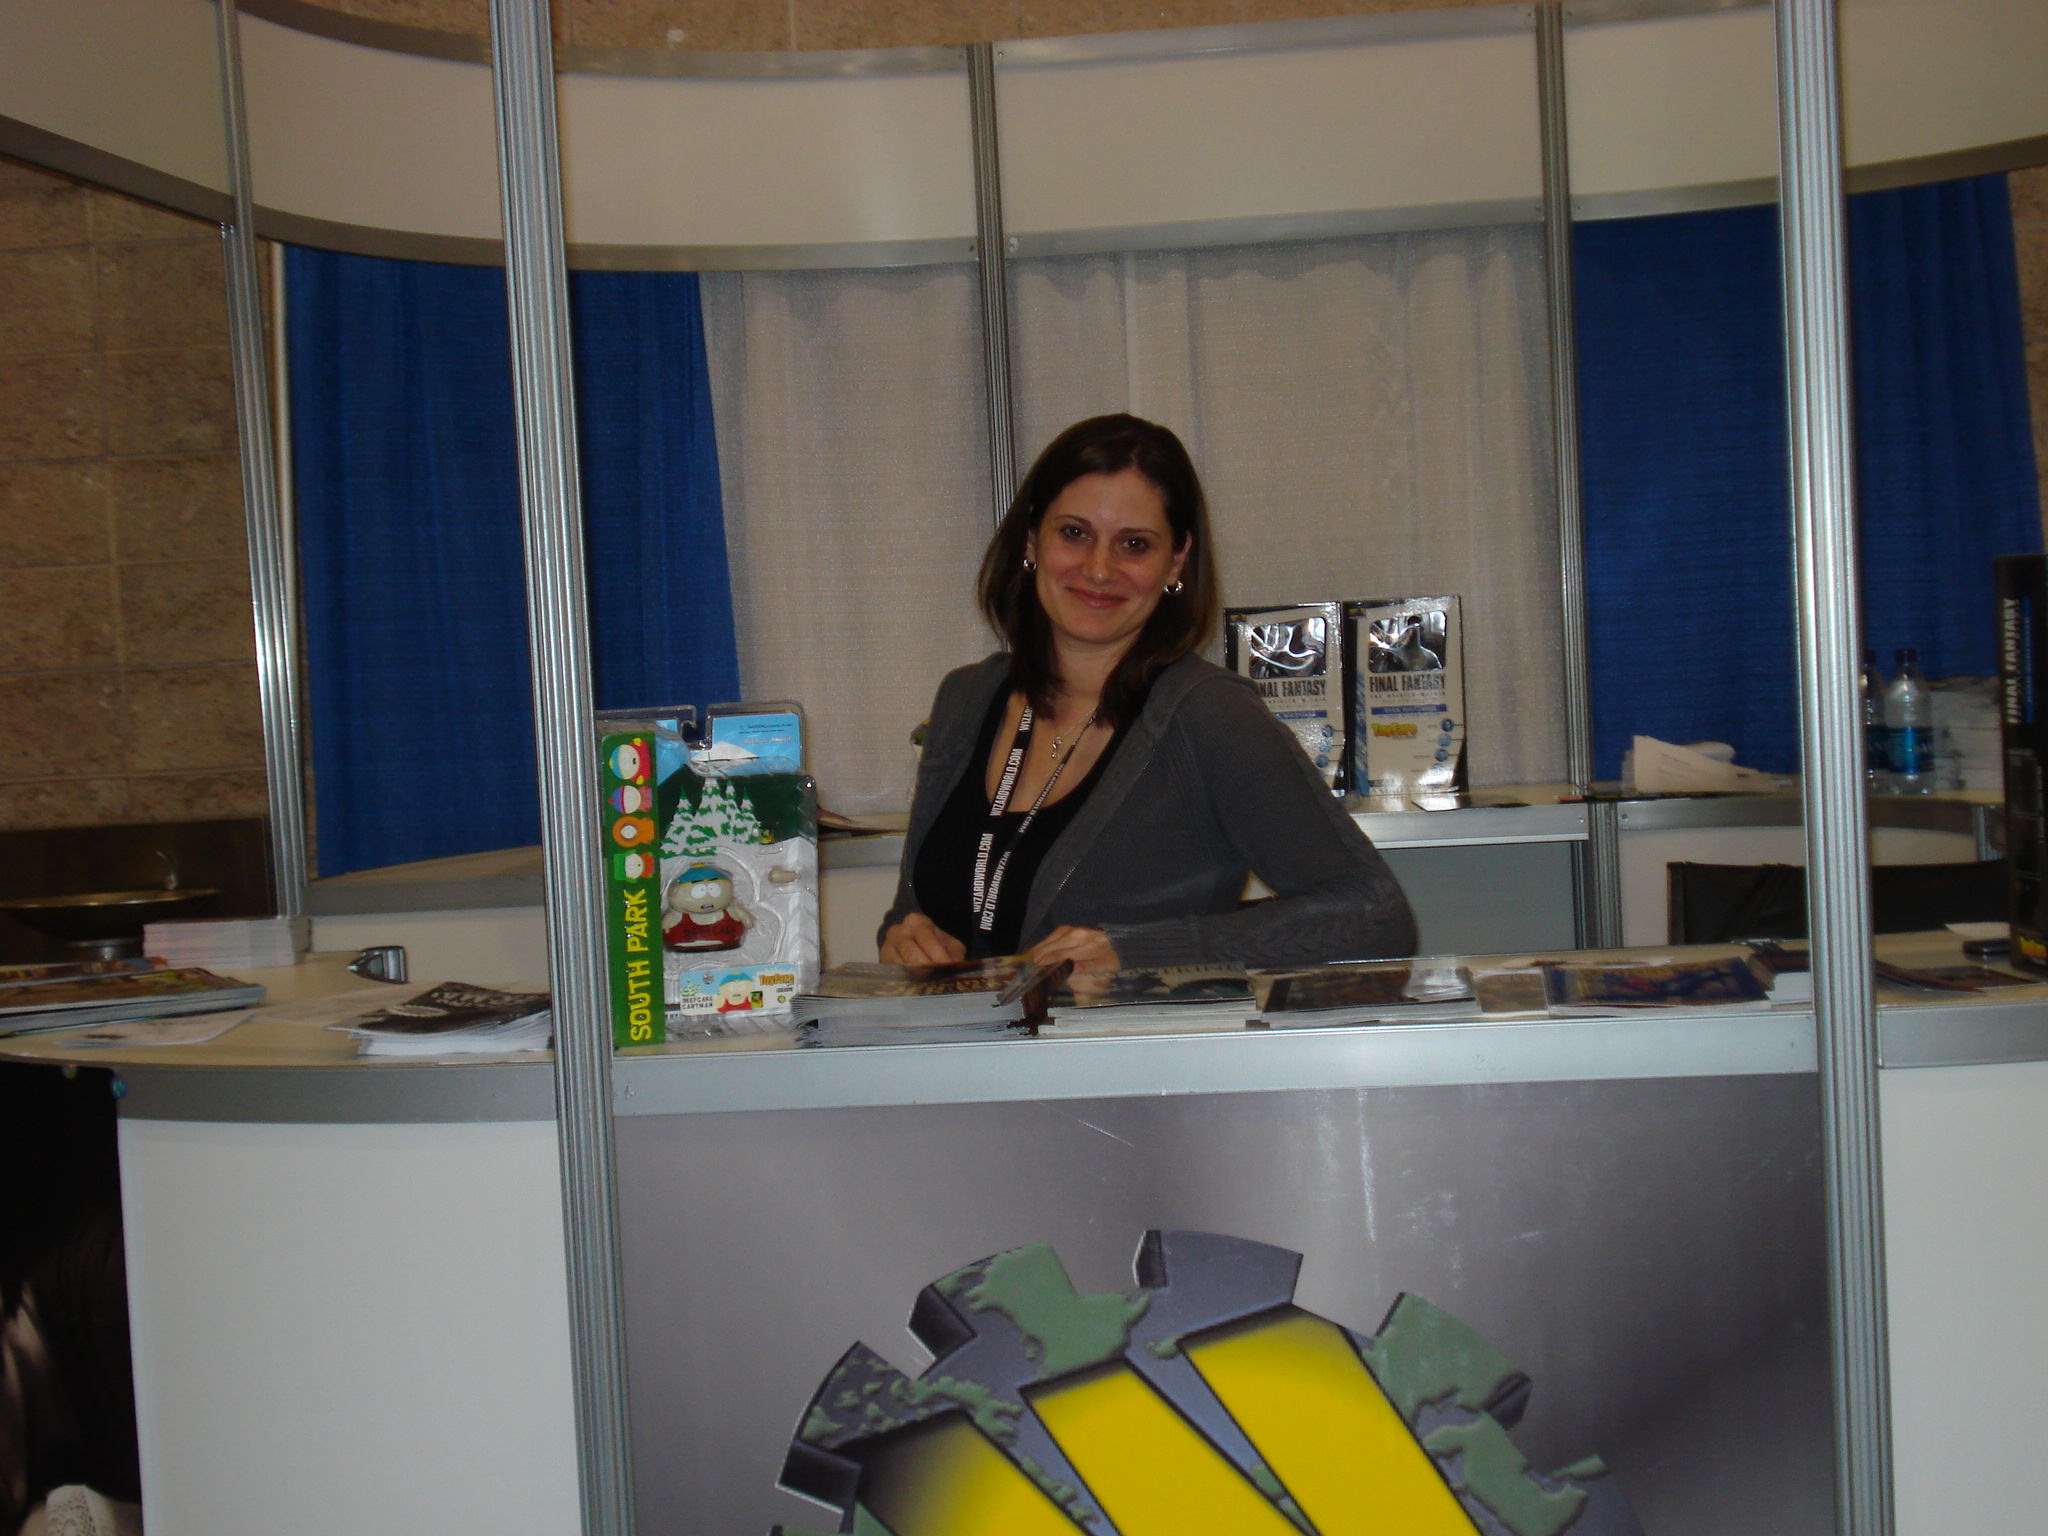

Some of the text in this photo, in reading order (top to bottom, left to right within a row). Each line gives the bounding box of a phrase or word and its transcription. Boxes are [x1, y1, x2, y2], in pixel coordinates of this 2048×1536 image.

[1257, 679, 1327, 698] NAL FANTASY
[1369, 674, 1446, 692] FINAL FANTASY
[989, 748, 1023, 817] WIZARDWORLD.COM
[972, 833, 994, 913] WIZARDWORLD.COM
[979, 851, 1011, 931] WIZARDWORLD.COM
[623, 888, 652, 1041] SOUTH PARK
